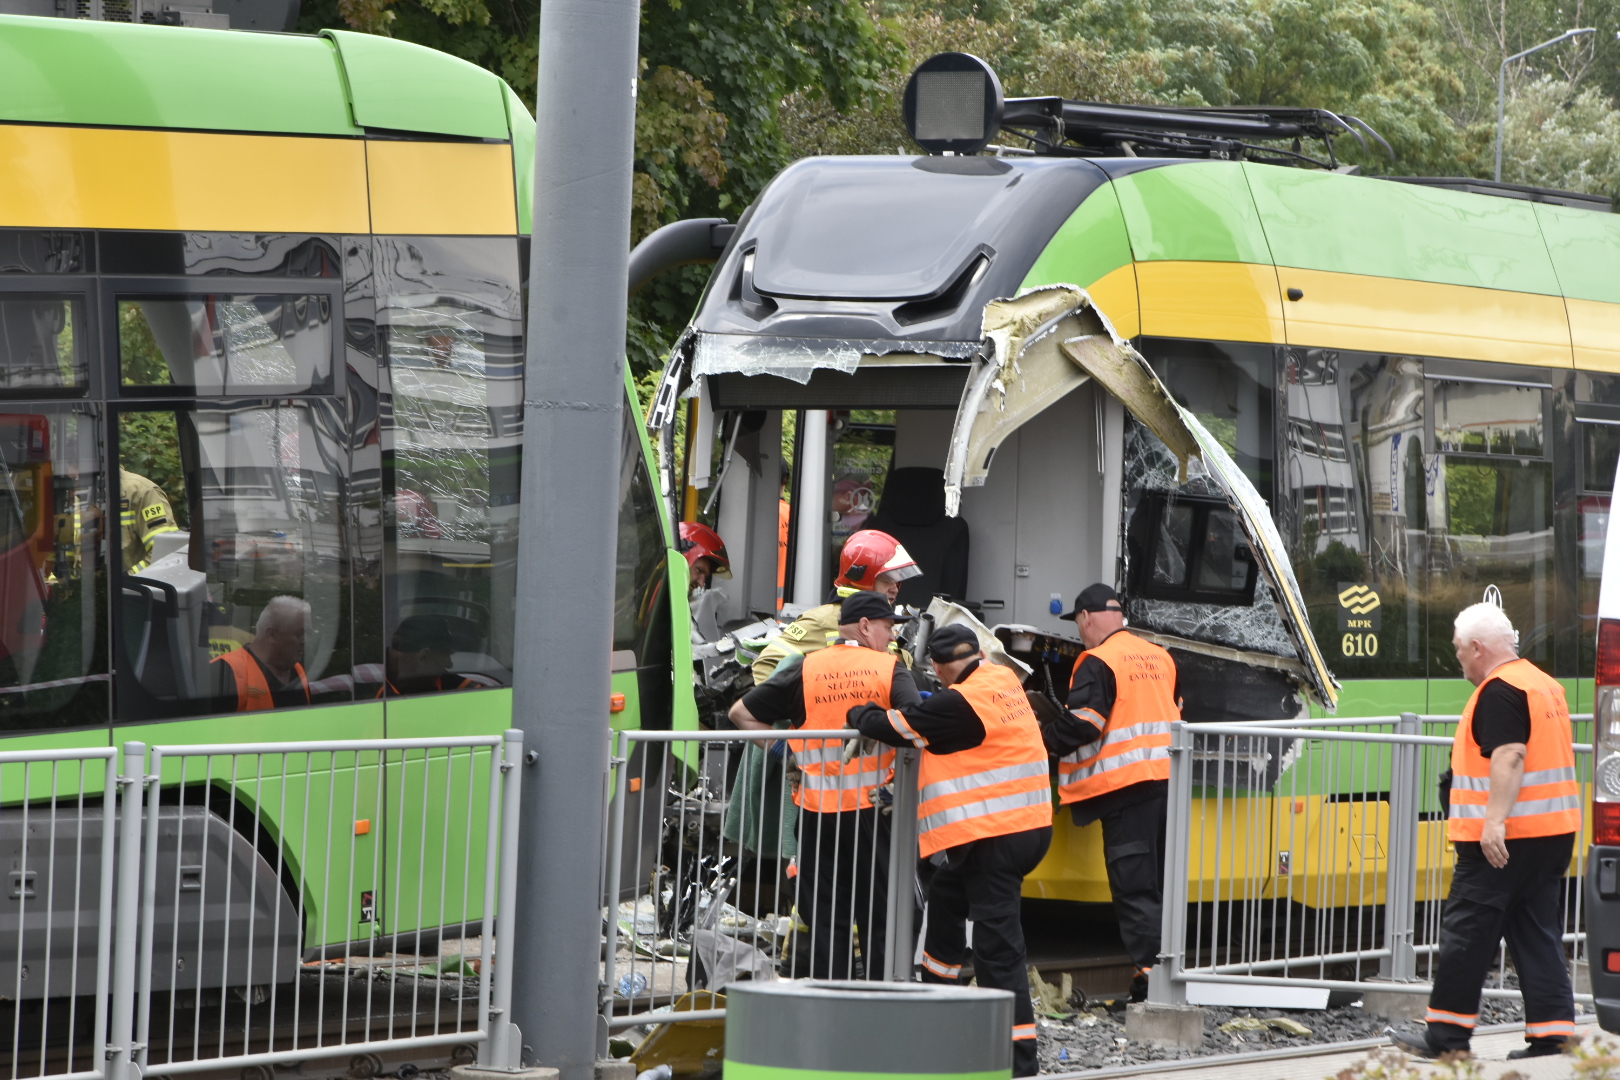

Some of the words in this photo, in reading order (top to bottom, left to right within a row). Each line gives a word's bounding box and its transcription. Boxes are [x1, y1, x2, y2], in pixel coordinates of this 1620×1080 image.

[144, 505, 162, 518] PSP
[787, 624, 804, 636] PSP
[1347, 619, 1372, 628] MPK
[1342, 632, 1378, 657] 610
[815, 669, 879, 682] ZAKŁADOWA
[827, 679, 866, 691] SŁUŻBA
[814, 690, 881, 704] RATOWNICZA
